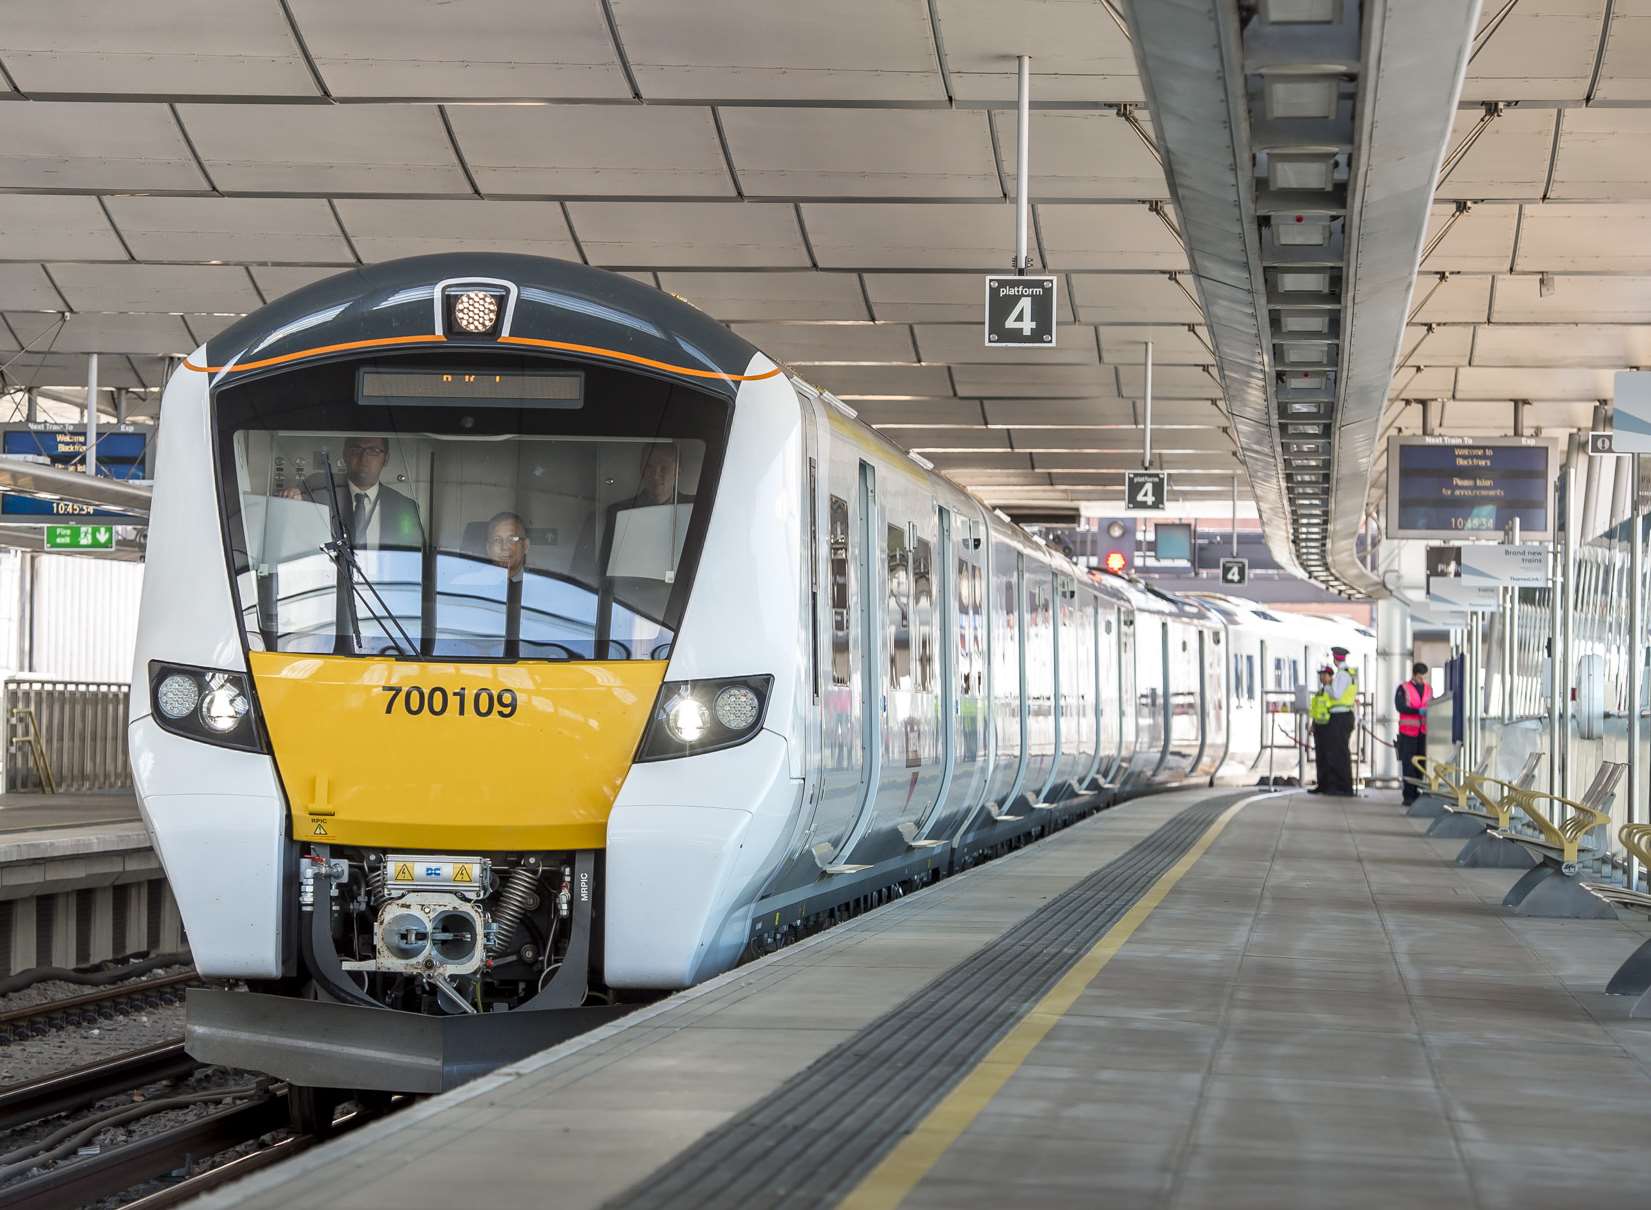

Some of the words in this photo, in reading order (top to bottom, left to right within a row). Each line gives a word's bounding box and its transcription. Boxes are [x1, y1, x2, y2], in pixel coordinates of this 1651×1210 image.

[999, 286, 1043, 297] platform
[1005, 296, 1036, 336] 4
[1425, 436, 1443, 445] Next
[1443, 437, 1463, 445] Train
[1464, 437, 1473, 445] To
[1136, 482, 1155, 506] 4
[56, 527, 71, 536] Fire
[1226, 566, 1240, 582] 4
[382, 686, 518, 719] 700109
[581, 872, 589, 902] MRPIC
